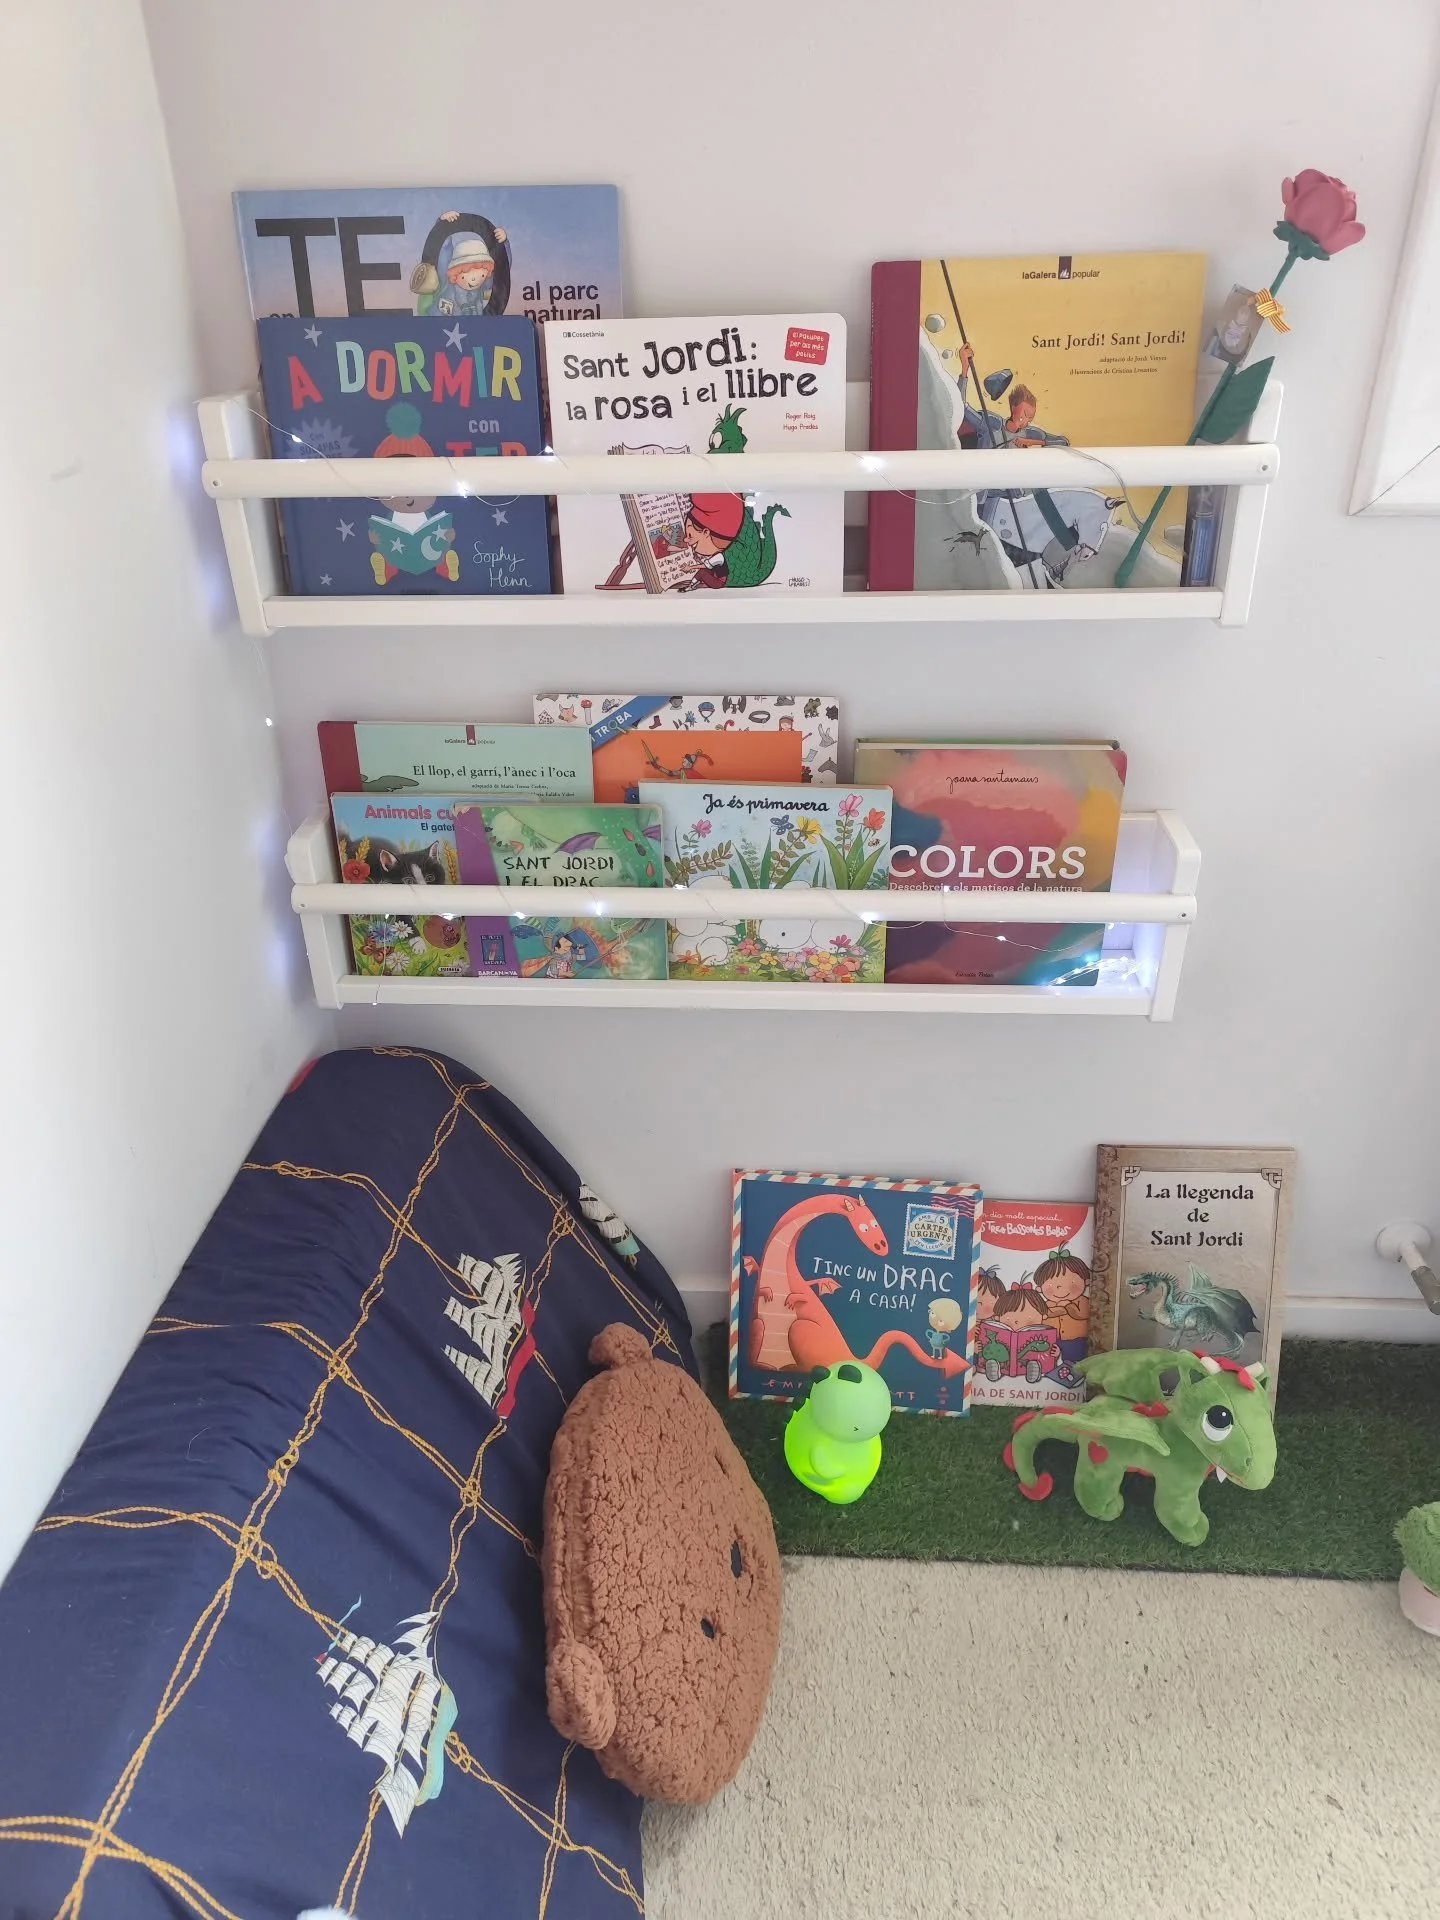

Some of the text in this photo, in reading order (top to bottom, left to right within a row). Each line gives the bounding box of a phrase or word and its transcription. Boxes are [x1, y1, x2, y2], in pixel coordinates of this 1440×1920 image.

[255, 212, 512, 317] TEO
[1022, 270, 1100, 280] laGalera popular
[522, 281, 599, 305] al parc
[523, 304, 600, 324] natural
[1032, 331, 1186, 350] Sant Jordi! Sant Jordi!
[563, 327, 757, 380] Sant Jordi:
[287, 340, 522, 411] A DORMIR
[566, 368, 818, 421] la rosa i el llibre
[468, 418, 500, 433] con
[472, 540, 525, 571] Sophy
[489, 568, 532, 588] Henn
[413, 765, 424, 776] El
[428, 766, 455, 779] llop,
[457, 766, 466, 776] el
[470, 766, 501, 779] garrí,
[541, 766, 545, 777] i
[364, 804, 432, 821] Animals
[703, 793, 830, 814] Ja és primavera
[420, 823, 429, 831] El
[503, 856, 614, 871] SANT JORDI
[889, 844, 1087, 880] COLORS
[521, 875, 543, 887] EL
[1017, 882, 1031, 892] de
[1146, 1183, 1254, 1204] La llegenda
[939, 1216, 945, 1224] 5
[1187, 1208, 1210, 1223] de
[910, 1231, 952, 1243] URGENTS
[914, 1223, 949, 1234] CARTES
[1151, 1230, 1243, 1247] Sant Jordi
[813, 1257, 954, 1293] TINC UN DRAC
[849, 1289, 917, 1313] A CASA!
[970, 1387, 1081, 1402] IA DE SANT JORDI
